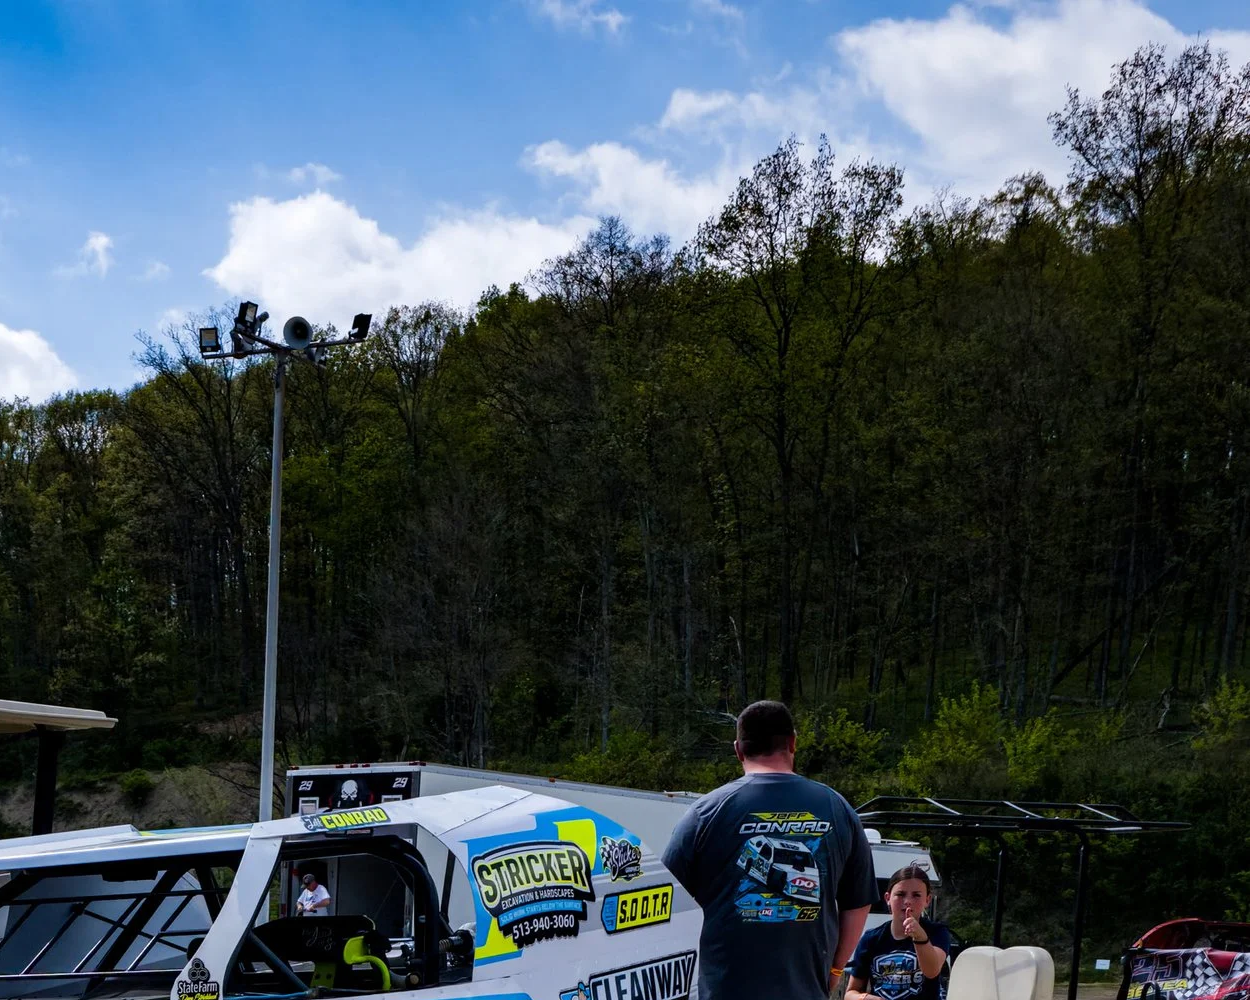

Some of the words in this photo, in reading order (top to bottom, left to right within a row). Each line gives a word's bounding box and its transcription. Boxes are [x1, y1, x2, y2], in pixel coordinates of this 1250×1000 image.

[299, 780, 314, 791] 29
[392, 777, 409, 788] 29
[321, 808, 388, 829] CONRAD
[767, 812, 808, 820] JEFF
[739, 821, 831, 834] CONRAD
[477, 849, 587, 903] STRICKER
[501, 891, 535, 910] EXCAVATION
[535, 890, 539, 900] &
[539, 888, 574, 899] HARDSCAPES
[513, 914, 575, 940] 513-940-3060
